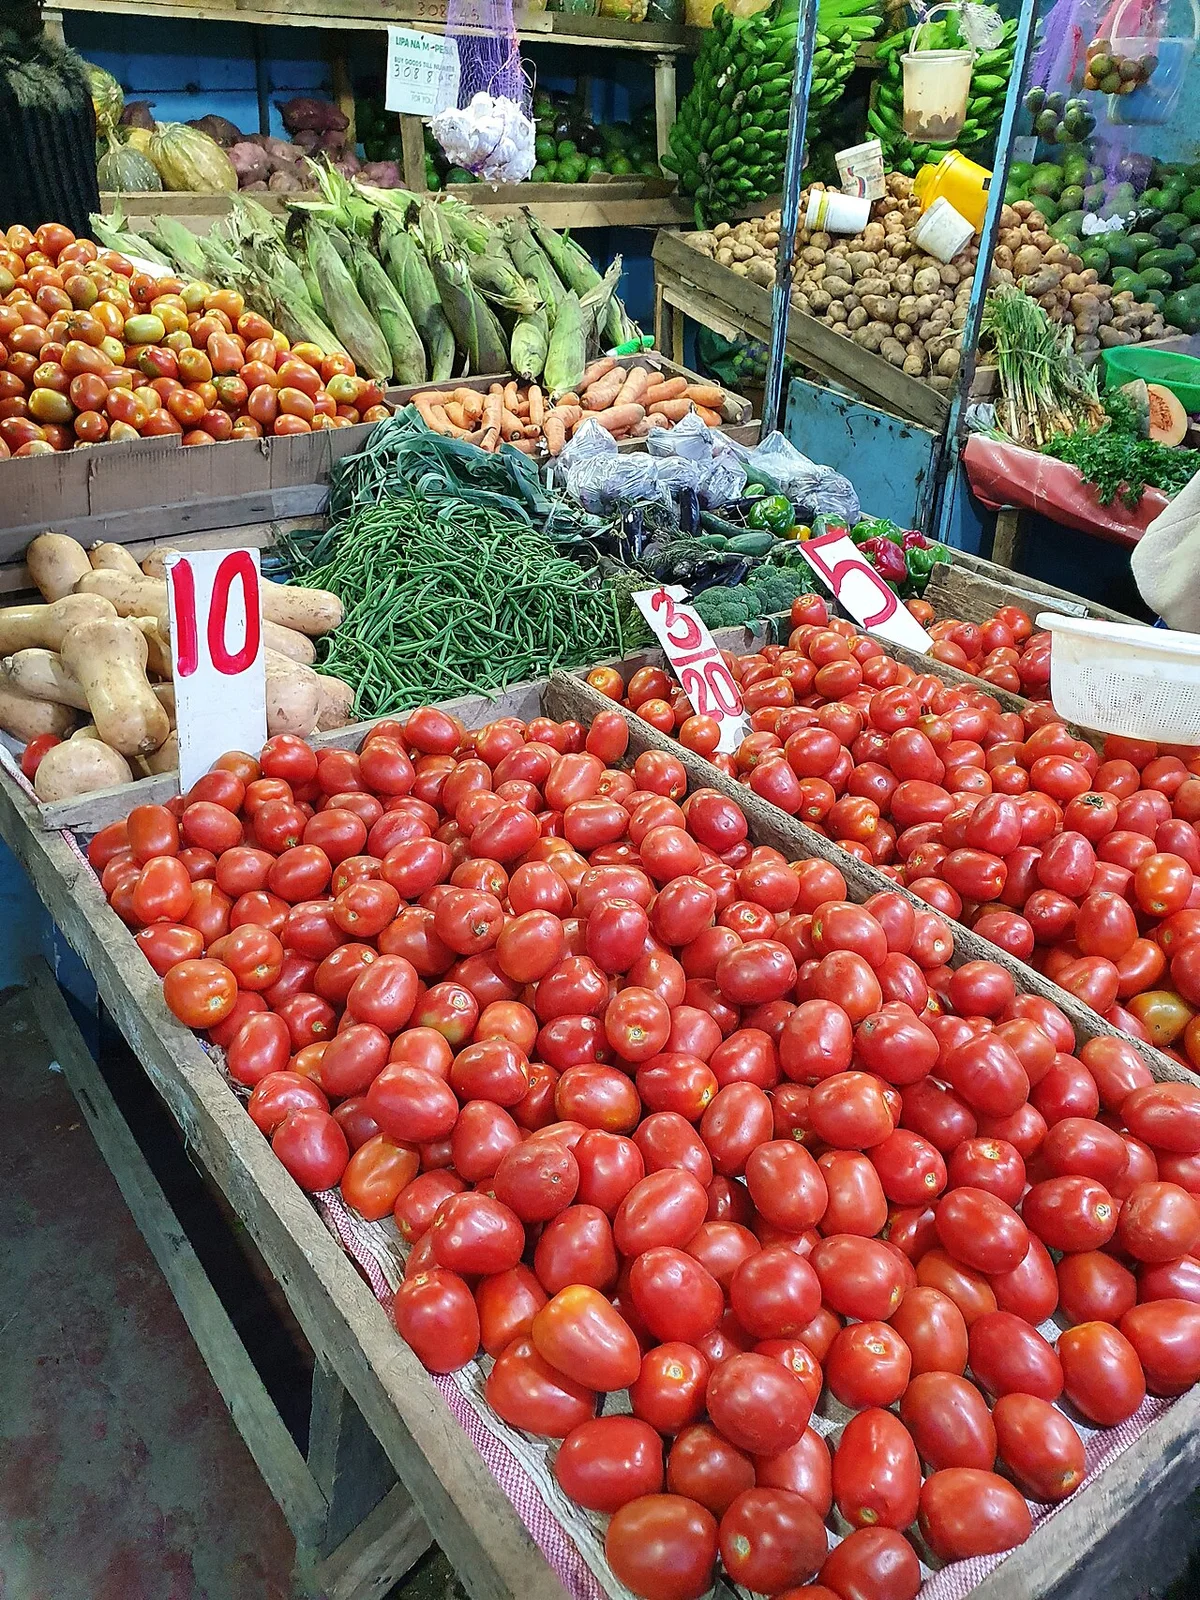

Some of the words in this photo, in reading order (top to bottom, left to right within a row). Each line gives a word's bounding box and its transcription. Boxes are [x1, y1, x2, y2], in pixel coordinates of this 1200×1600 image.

[395, 36, 409, 47] LIPA
[410, 39, 420, 49] NA
[405, 58, 422, 67] GOODS
[801, 528, 898, 631] 5
[171, 550, 260, 678] 10
[651, 587, 702, 650] 3
[681, 662, 745, 722] 20
